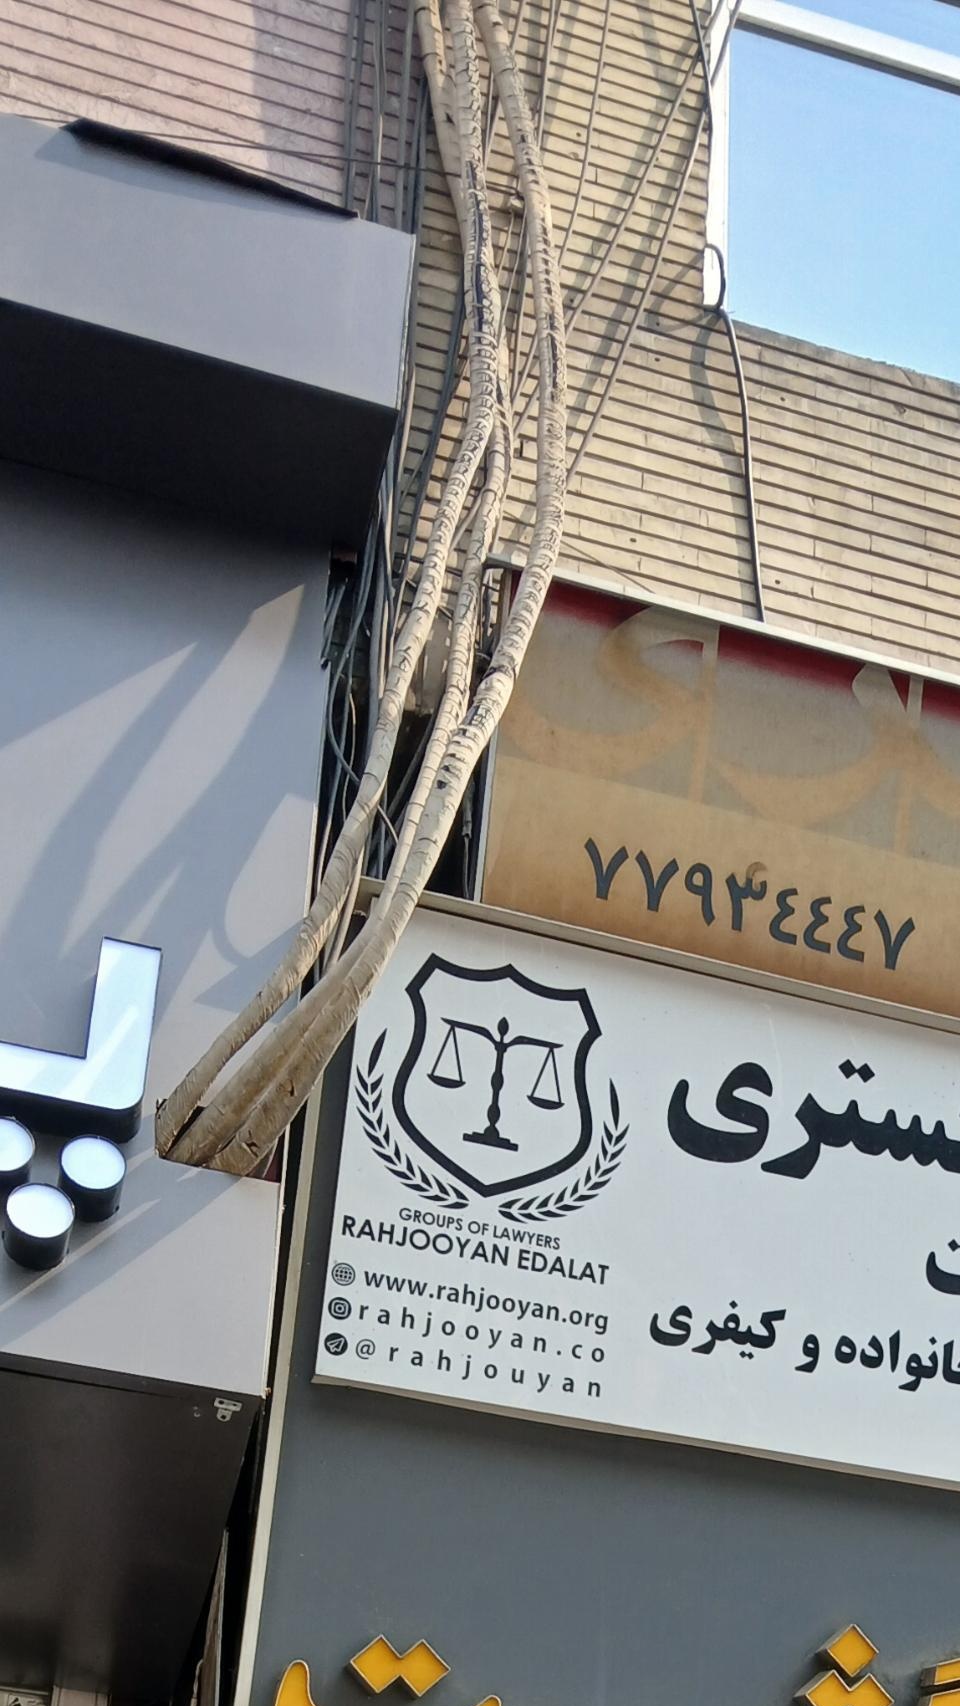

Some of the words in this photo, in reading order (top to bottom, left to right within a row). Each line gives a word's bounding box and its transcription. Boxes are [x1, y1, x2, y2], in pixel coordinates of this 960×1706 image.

[342, 1215, 508, 1267] RAHJOOYAN
[517, 1249, 610, 1286] EDALAT
[399, 1207, 464, 1233] GROUPS
[467, 1220, 490, 1236] OF
[493, 1223, 561, 1251] LAWYERS
[364, 1269, 609, 1335] www.rahjooyan.org
[649, 1300, 786, 1359] کیفری
[795, 1333, 820, 1373] و
